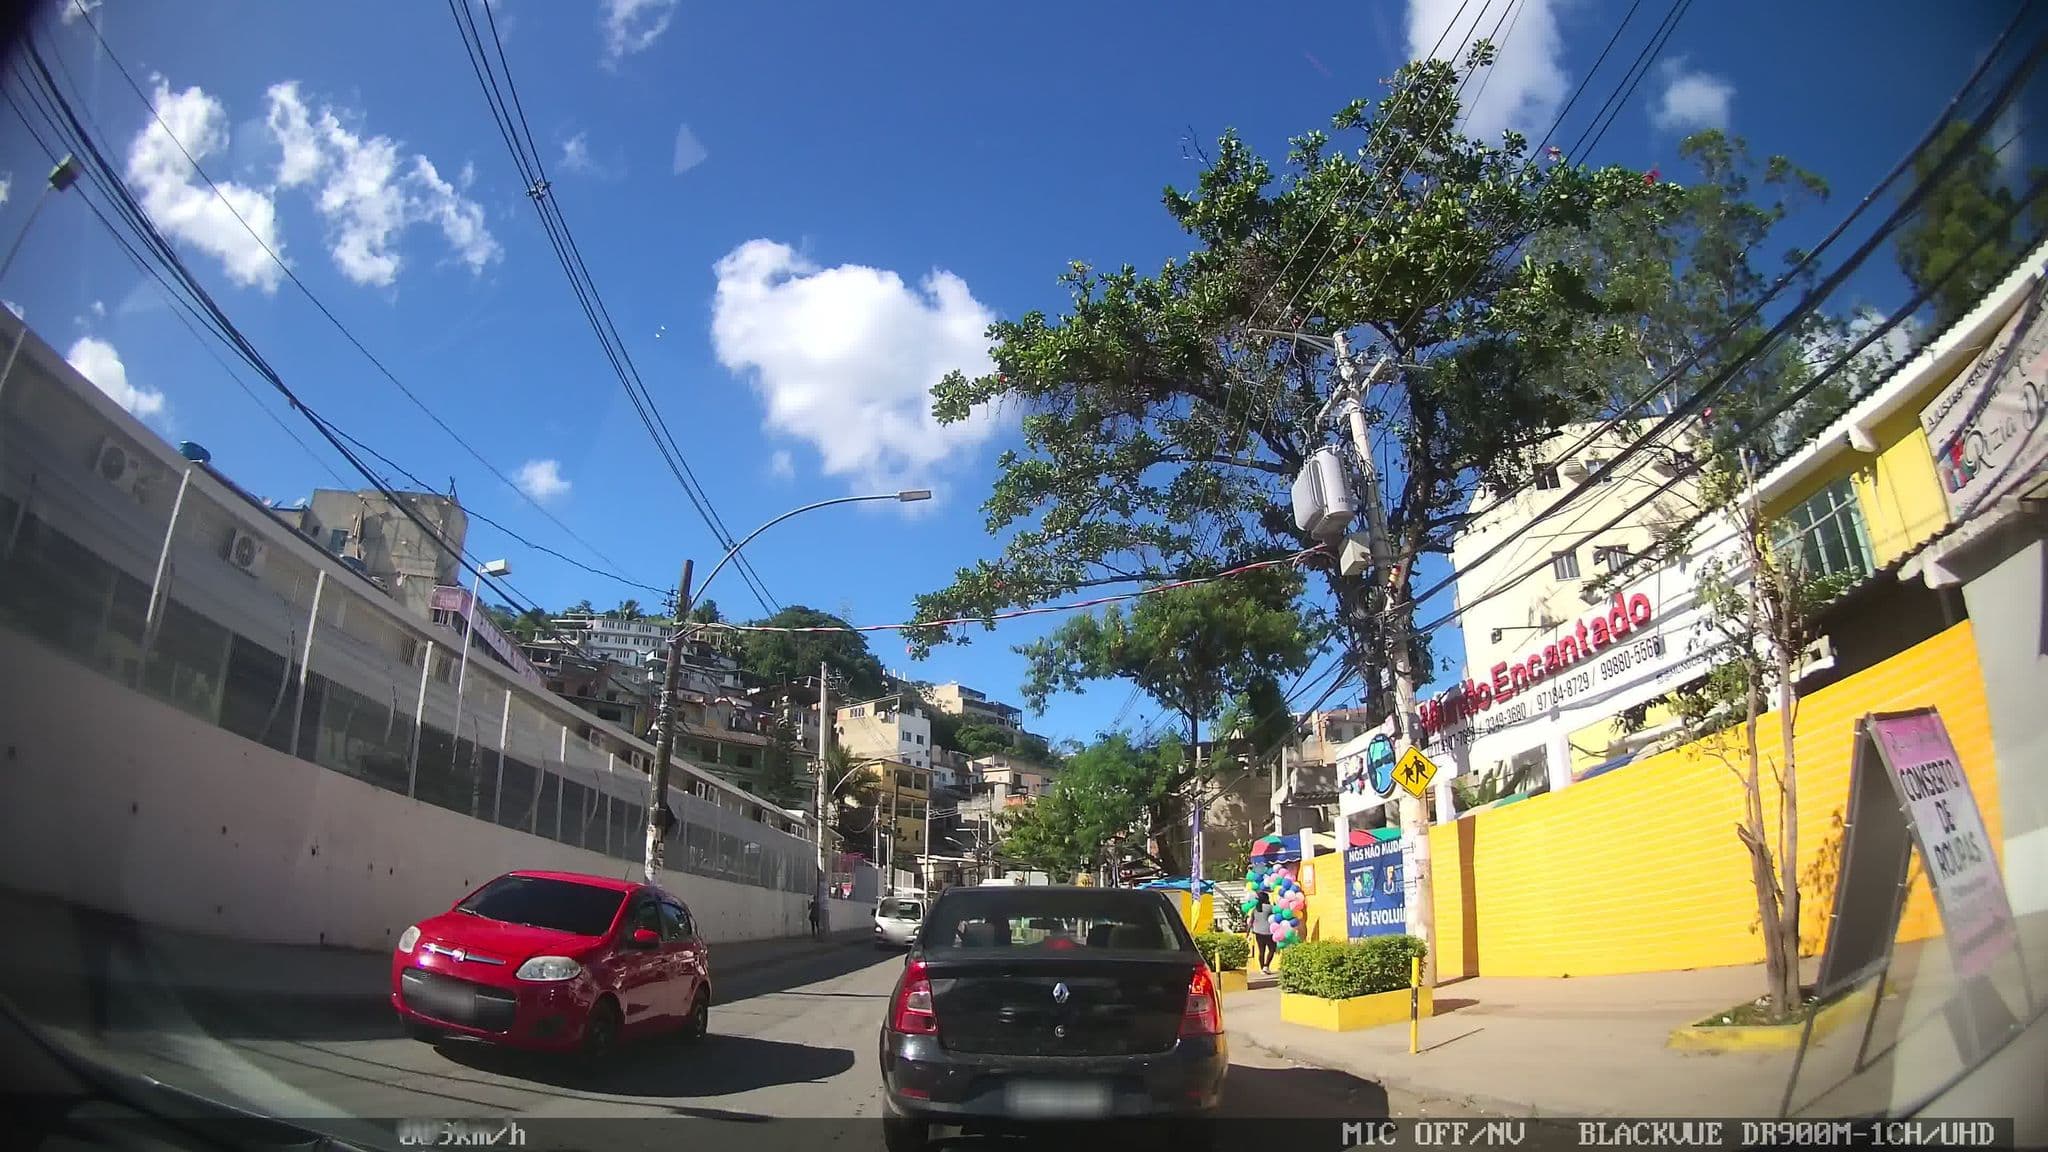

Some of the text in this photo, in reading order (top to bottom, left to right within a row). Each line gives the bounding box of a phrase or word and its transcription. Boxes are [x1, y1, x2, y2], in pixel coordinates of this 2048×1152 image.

[1490, 591, 1652, 705] Encantado
[1537, 671, 1590, 711] 97184-8729
[1600, 635, 1661, 681] 99880-5566
[1900, 759, 1960, 801] CONSERTO
[1935, 799, 1956, 834] DE
[1349, 847, 1363, 863] NÓS
[1364, 843, 1380, 859] NÃO
[1934, 831, 1982, 879] ROUPAS
[1351, 903, 1406, 927] NÓS EVOLUÍ
